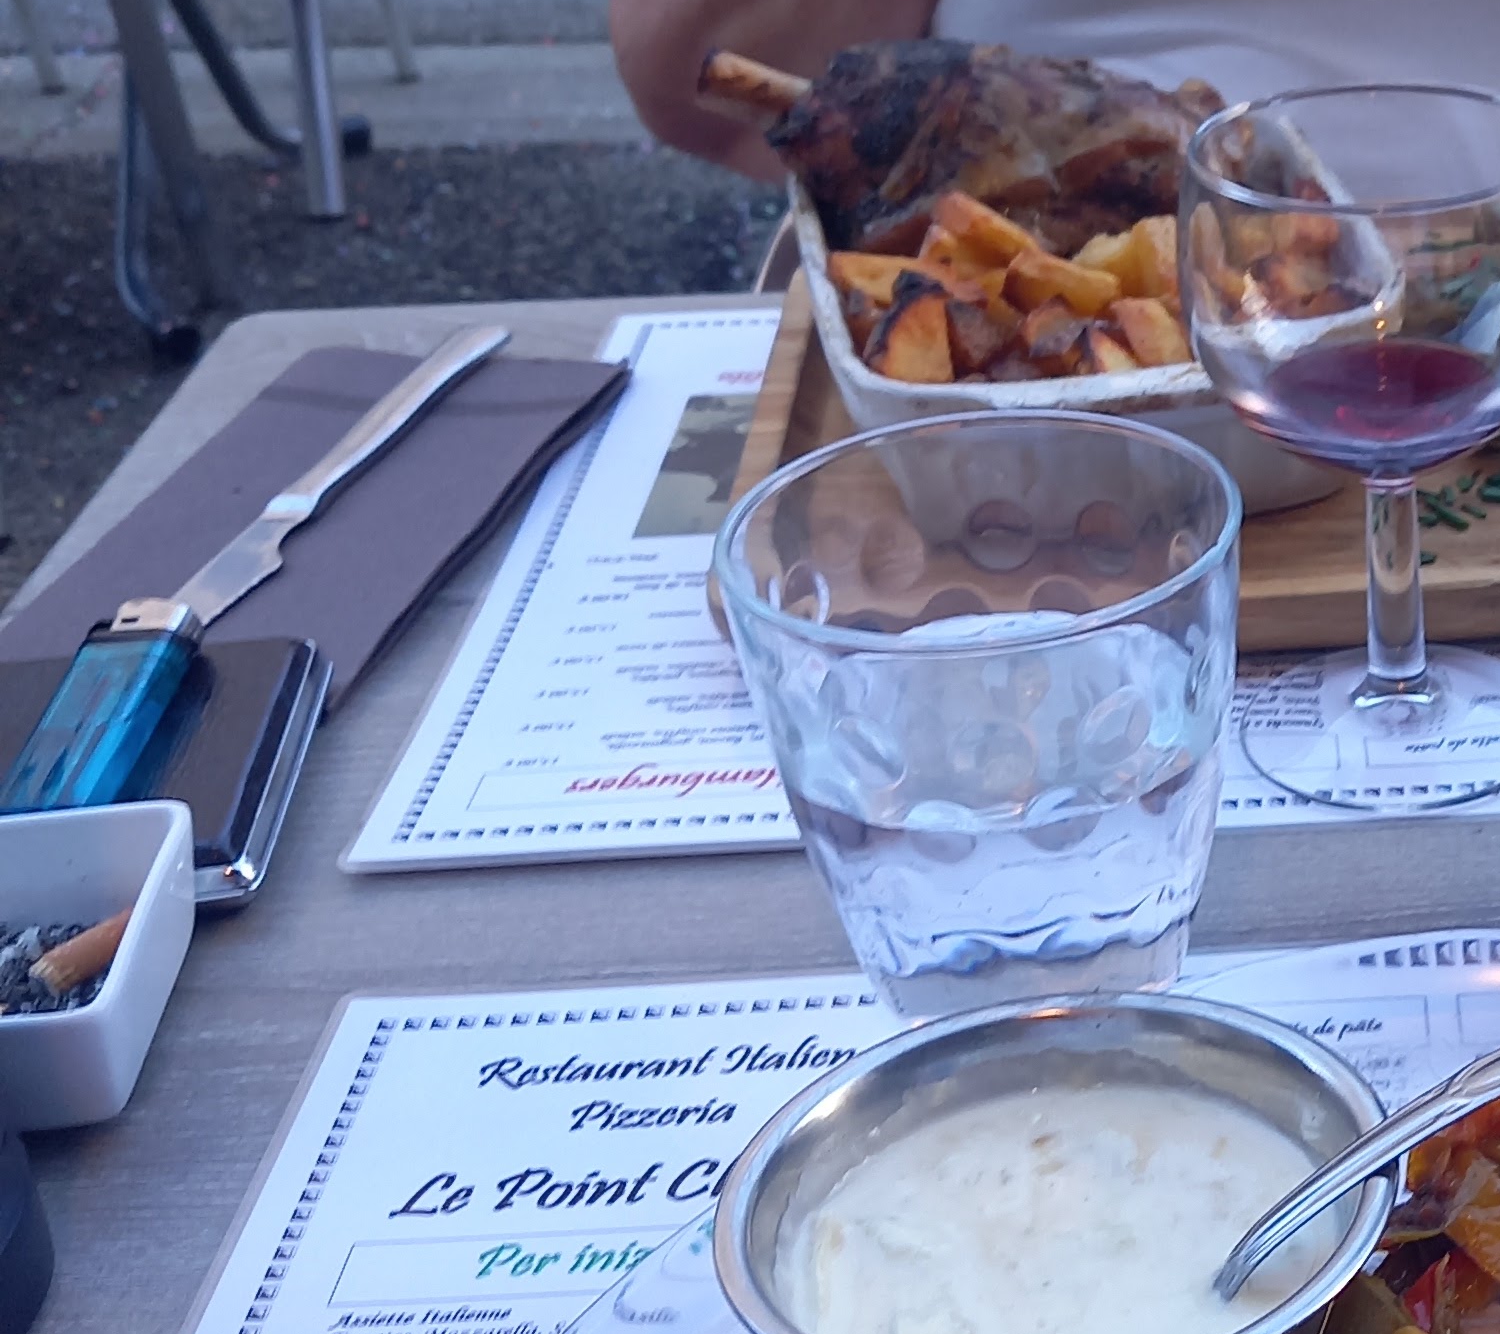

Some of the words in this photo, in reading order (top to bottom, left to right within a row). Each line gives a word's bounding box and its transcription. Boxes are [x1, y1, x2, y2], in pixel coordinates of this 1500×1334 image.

[477, 1045, 720, 1091] Restaurant
[720, 1033, 858, 1075] Italien
[568, 1096, 740, 1133] Pizzeria
[387, 1170, 476, 1219] Le
[492, 1161, 665, 1213] Point
[475, 1242, 562, 1279] Per
[327, 1310, 417, 1332] Assiette
[420, 1305, 513, 1325] Italienne
